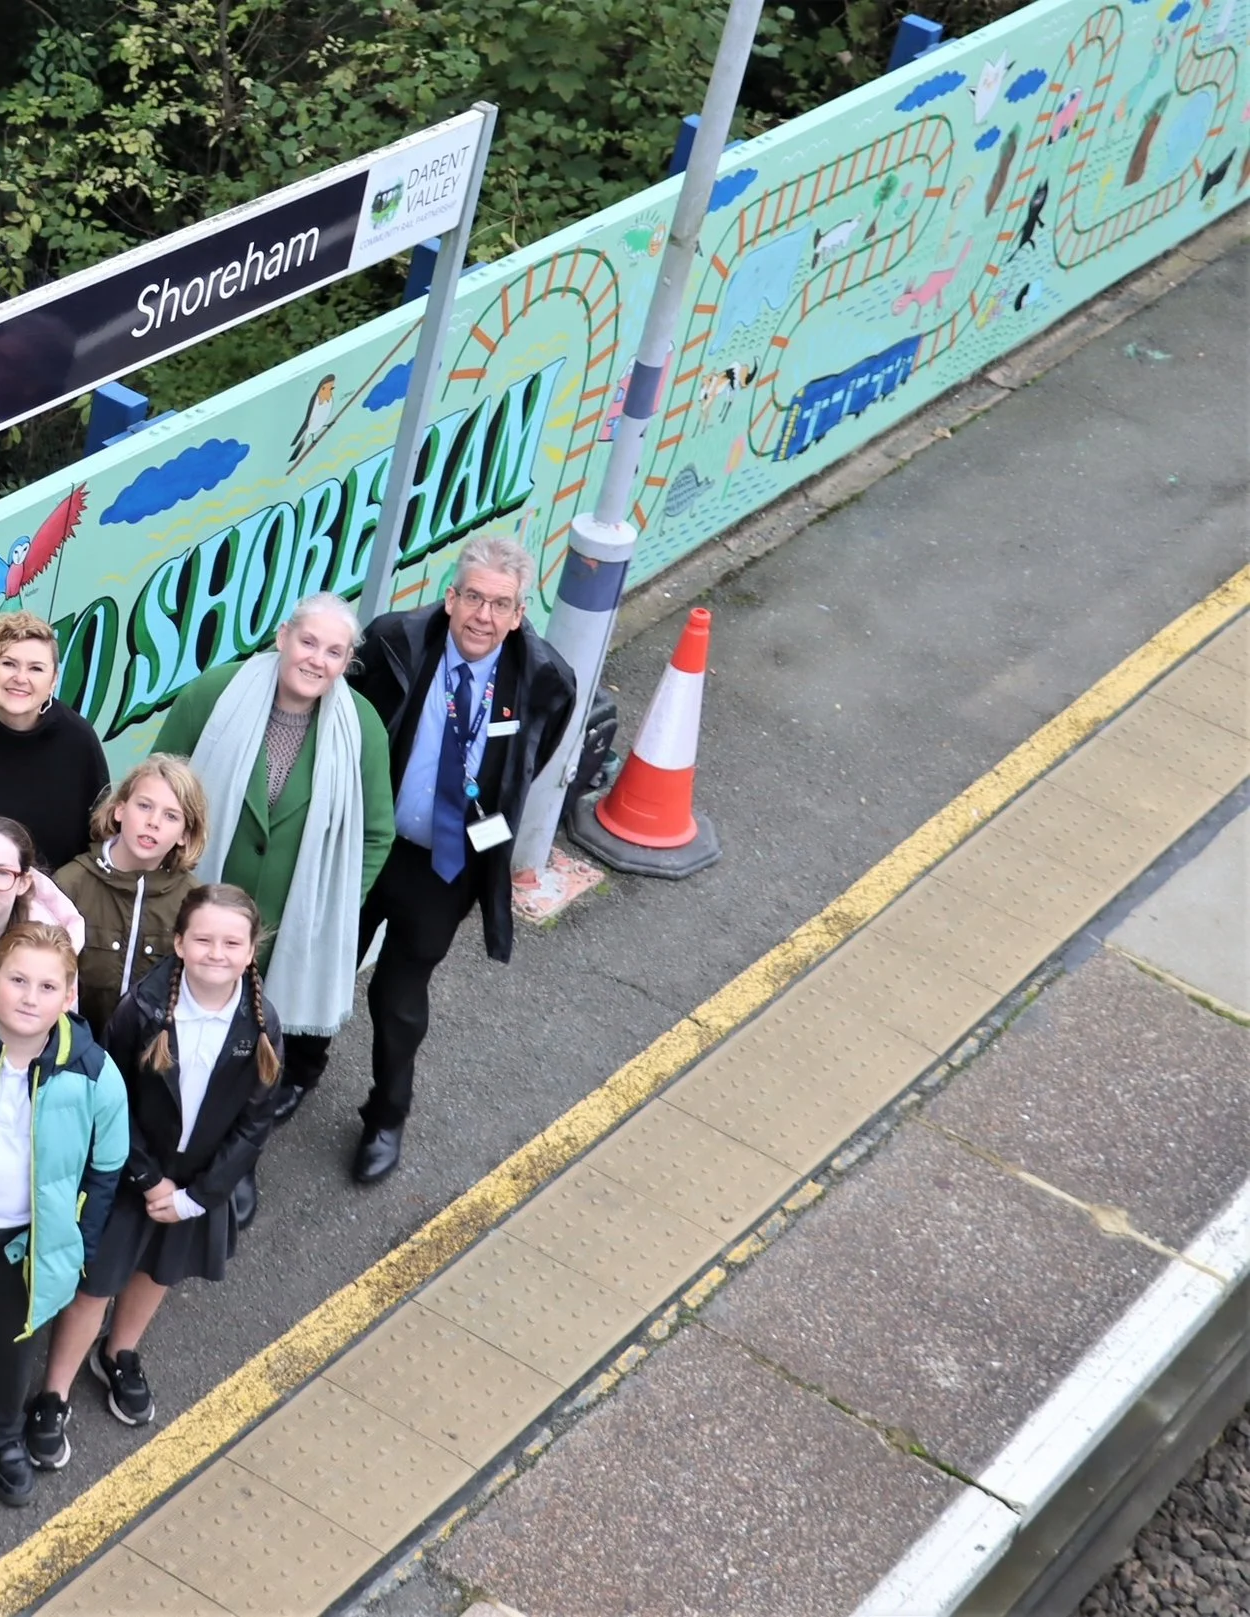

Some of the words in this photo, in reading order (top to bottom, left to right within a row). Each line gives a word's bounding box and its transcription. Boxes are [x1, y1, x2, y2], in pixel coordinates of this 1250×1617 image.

[407, 146, 470, 189] DARENT
[406, 173, 462, 213] VALLEY
[130, 226, 320, 338] Shoreham
